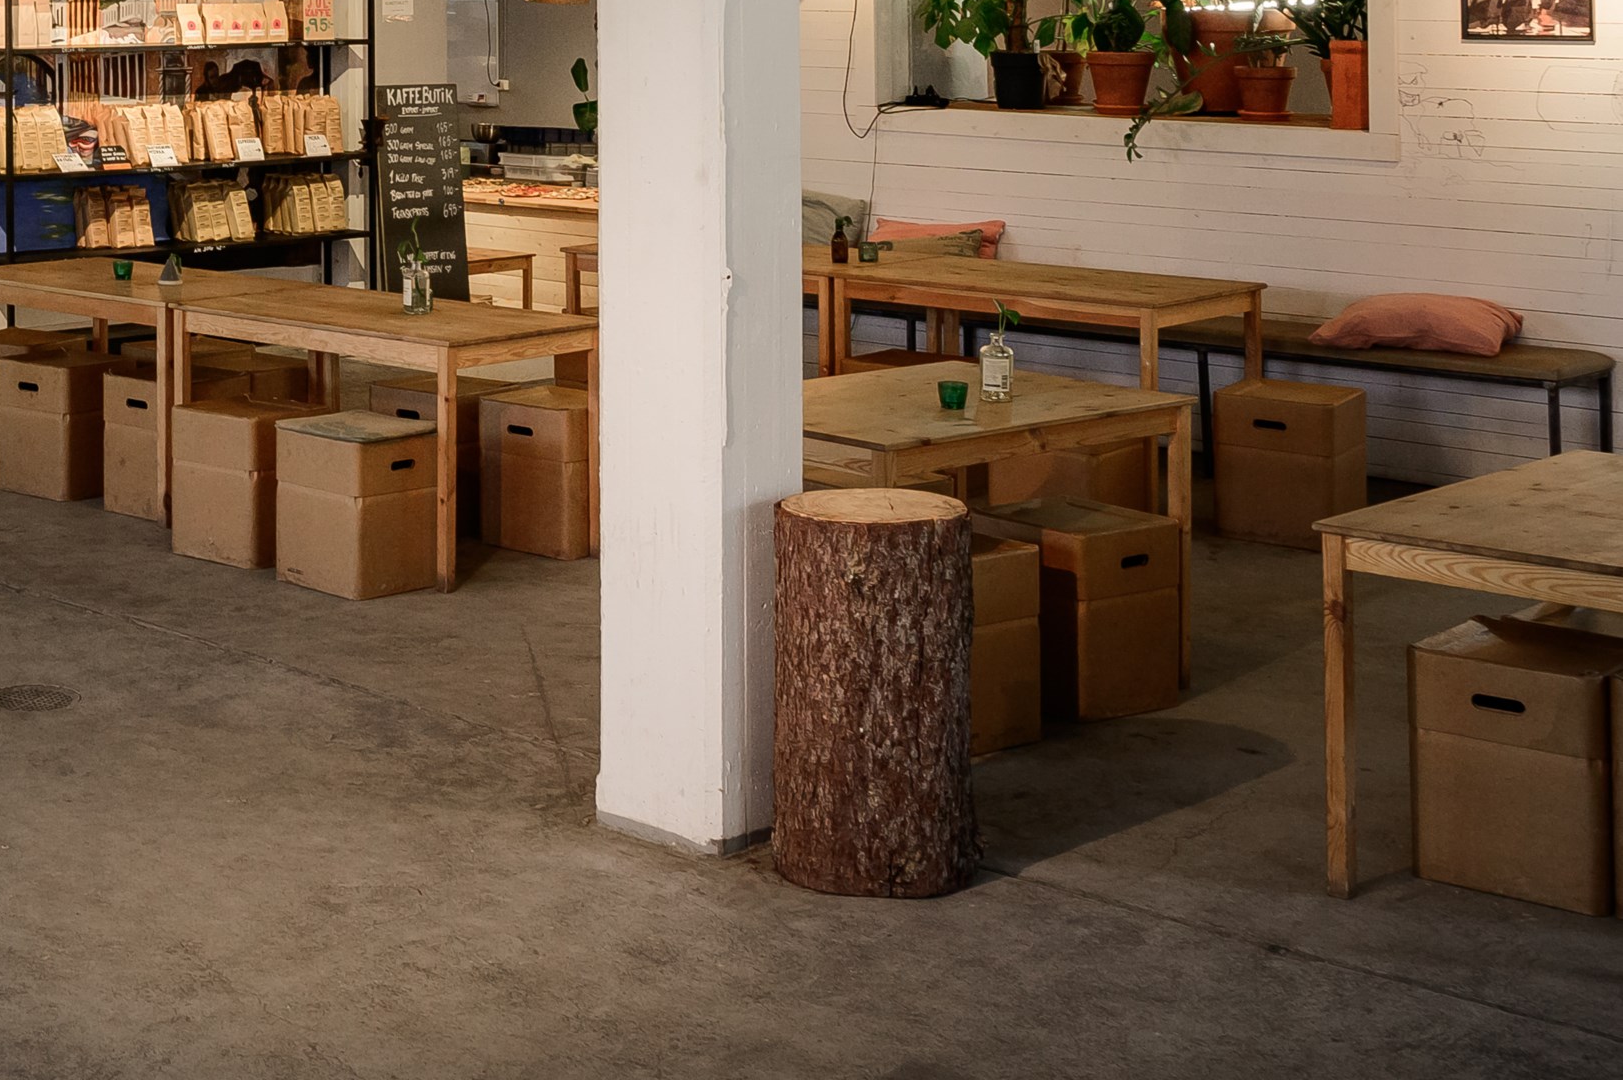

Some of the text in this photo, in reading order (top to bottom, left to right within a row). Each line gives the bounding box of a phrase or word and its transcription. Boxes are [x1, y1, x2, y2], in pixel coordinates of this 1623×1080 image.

[305, 8, 331, 17] KAFFE
[384, 123, 398, 136] 500
[387, 139, 399, 151] 300
[387, 153, 398, 164] 300
